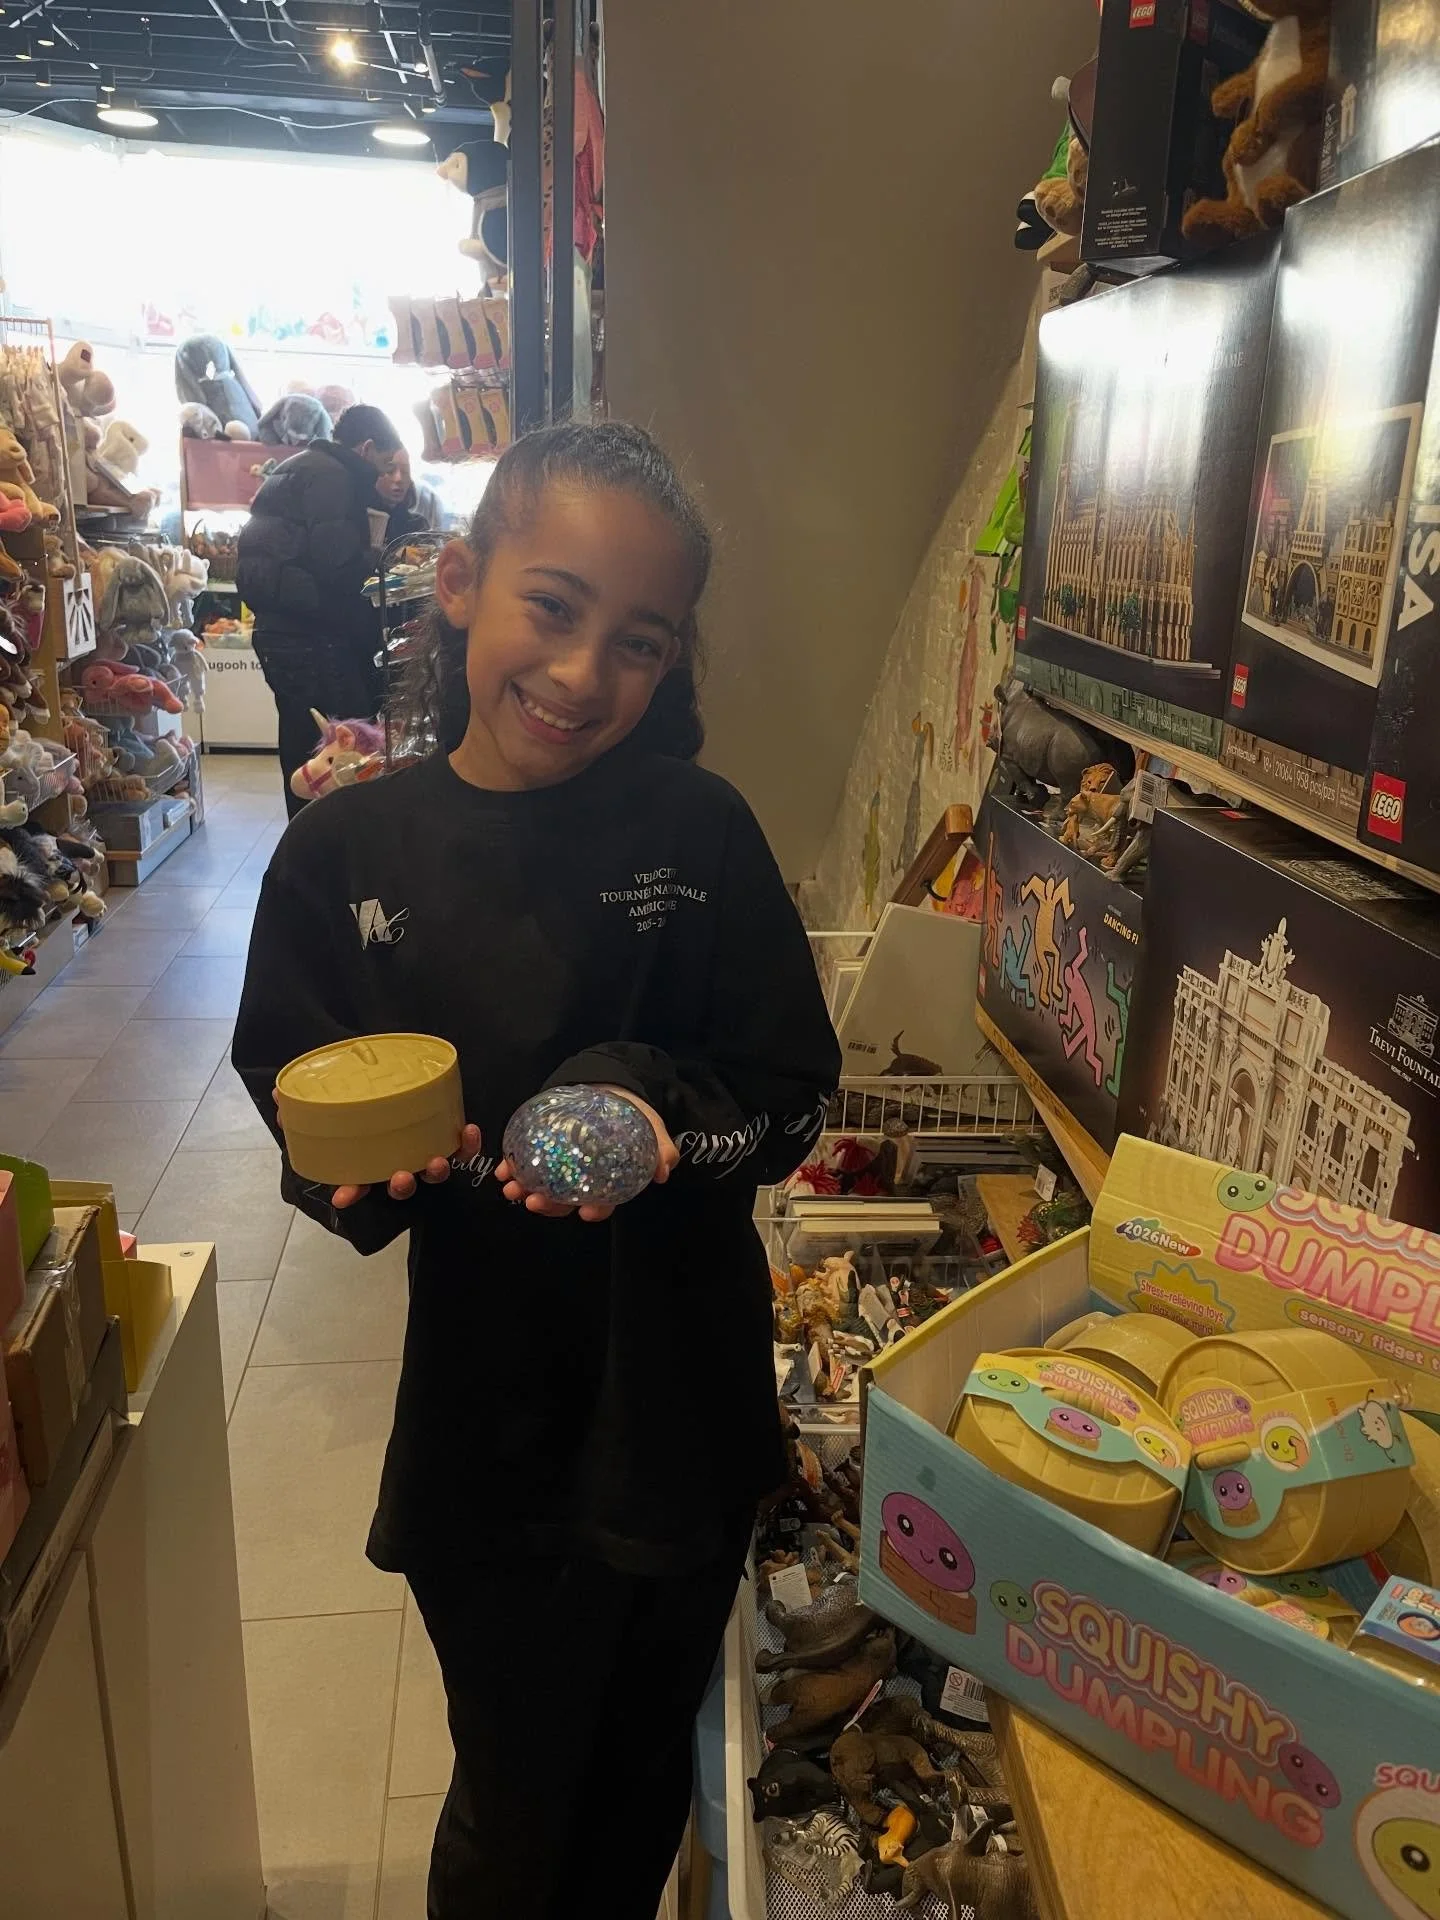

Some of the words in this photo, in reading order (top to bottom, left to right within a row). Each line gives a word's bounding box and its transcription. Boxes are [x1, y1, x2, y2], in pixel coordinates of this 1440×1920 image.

[1132, 5, 1156, 19] LEGO
[1275, 760, 1293, 783] 21064
[1296, 770, 1309, 790] 958
[1370, 790, 1401, 823] LEGO
[1103, 912, 1132, 940] DANCING
[1369, 1026, 1396, 1058] TREVI
[1397, 1045, 1440, 1089] FOUNTAI
[1124, 1220, 1190, 1256] 2026New
[1300, 1309, 1364, 1344] sensory
[1371, 1333, 1424, 1365] fidget
[1053, 1361, 1130, 1402] SQUISHY
[1182, 1390, 1235, 1423] SQUISHY
[1034, 1583, 1293, 1764] SQUISHY
[1005, 1622, 1325, 1849] DUMPLING
